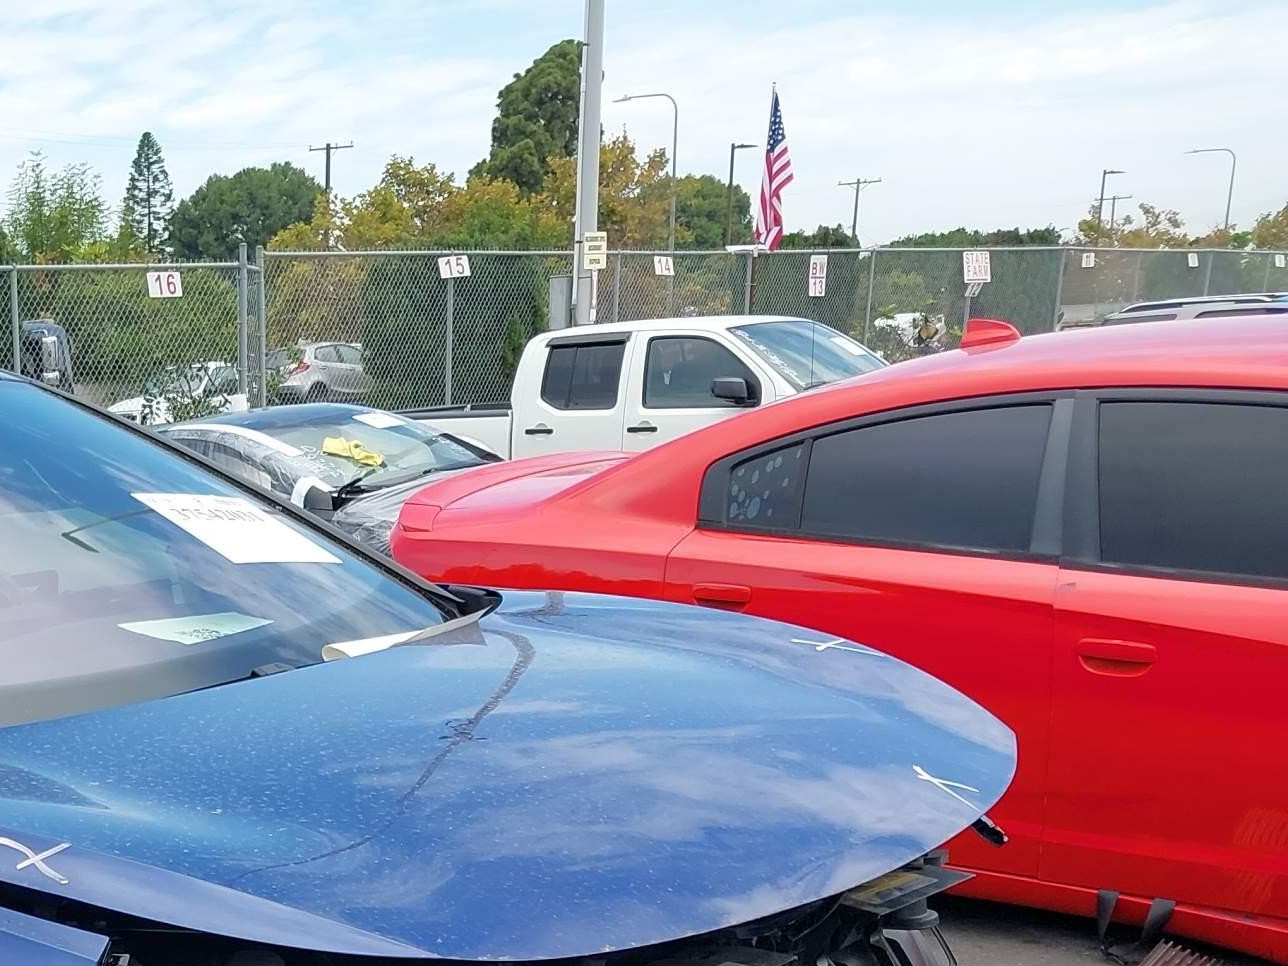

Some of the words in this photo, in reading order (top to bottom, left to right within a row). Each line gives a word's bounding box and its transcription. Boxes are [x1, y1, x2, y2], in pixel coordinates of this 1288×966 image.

[444, 257, 465, 276] 15
[657, 257, 671, 274] 14
[964, 252, 989, 265] STATE
[966, 264, 989, 278] FARM
[154, 273, 177, 296] 16
[812, 279, 824, 296] 13
